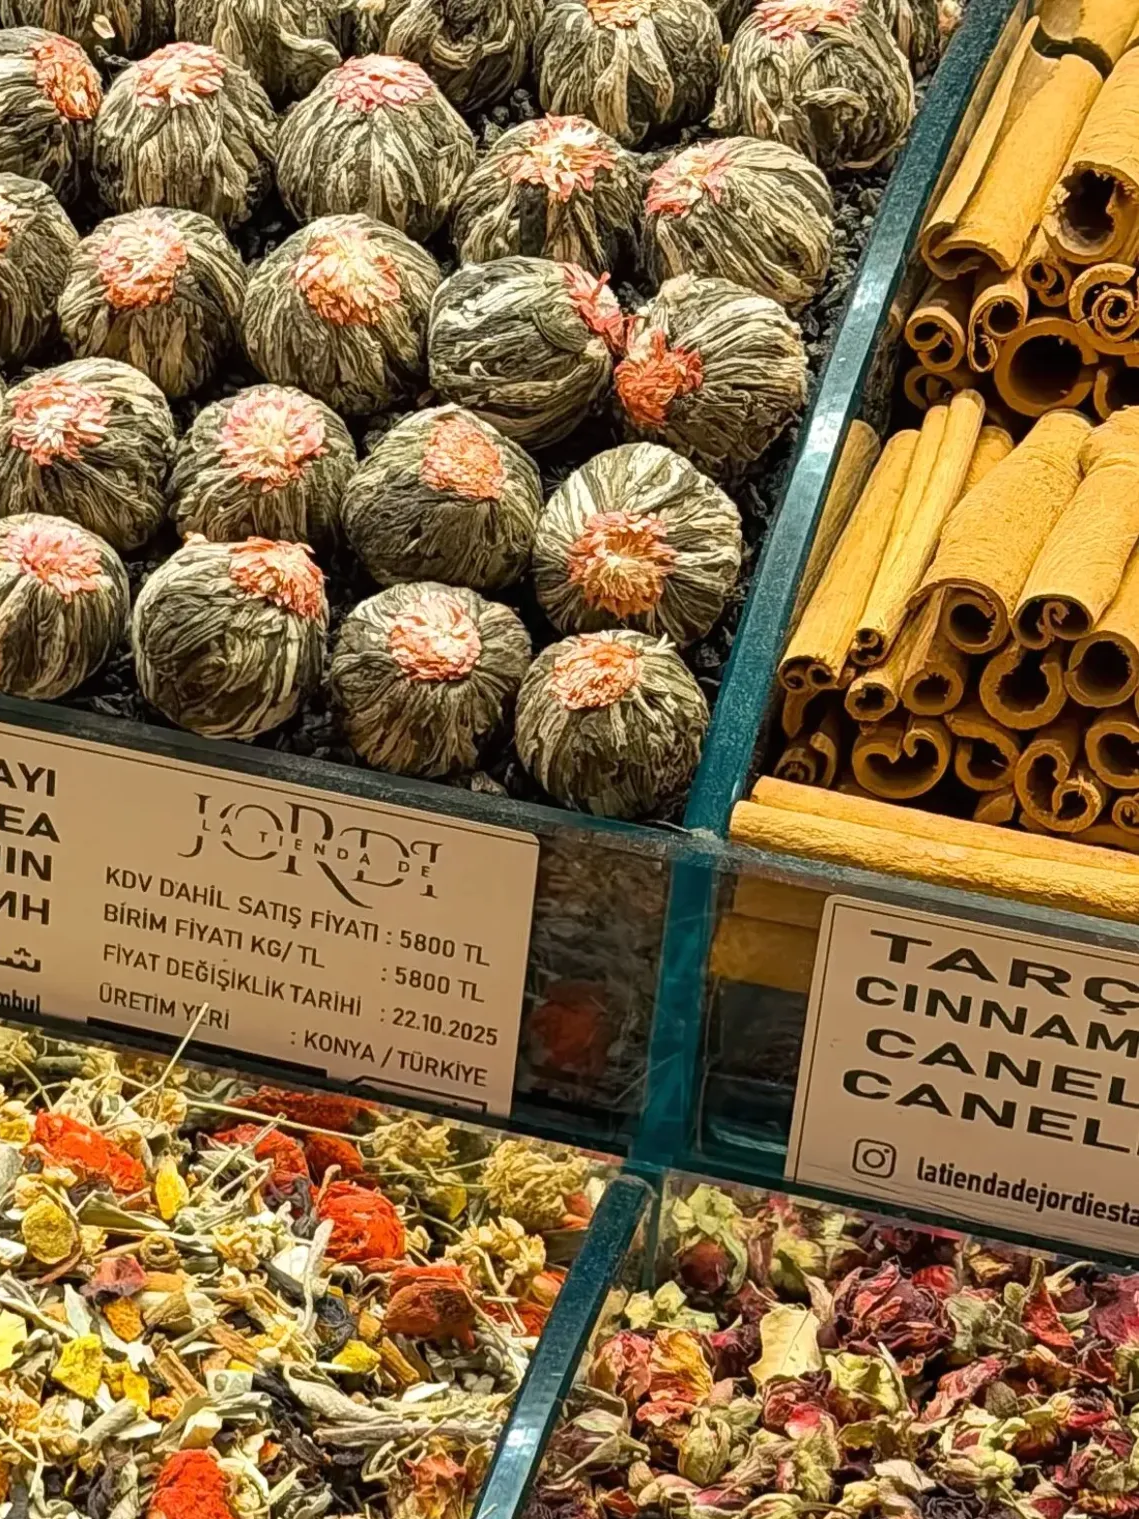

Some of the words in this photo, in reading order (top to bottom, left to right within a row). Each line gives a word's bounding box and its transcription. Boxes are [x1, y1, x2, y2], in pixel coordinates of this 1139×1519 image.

[259, 831, 370, 866] TIENDA
[398, 861, 430, 878] DE
[103, 901, 167, 934] BİRİM
[175, 917, 242, 950] FİYATI
[251, 931, 293, 963] KG/
[297, 946, 325, 968] TL
[395, 967, 450, 996] 5800
[457, 980, 485, 1003] TL
[105, 867, 153, 893] KDV
[160, 878, 229, 911] DAHİL
[238, 896, 301, 929] SATIŞ
[311, 909, 378, 942] FİYATI
[399, 931, 455, 959] 5800
[463, 944, 490, 967] TL
[103, 943, 160, 973] FİYAT
[166, 958, 285, 1001] DEĞİŞİKLİK
[290, 982, 361, 1017] TARİHİ
[393, 1008, 498, 1046] 22.10.2025
[870, 930, 1139, 1015] TARÇ
[99, 982, 176, 1018] ÜRETİM
[182, 1000, 229, 1030] YERİ
[304, 1030, 375, 1063] KONYA
[398, 1050, 487, 1087] TÜRKİYE
[856, 976, 1139, 1058] CINNAM
[866, 1029, 1139, 1110] CANEL
[843, 1070, 1139, 1156] CANEL
